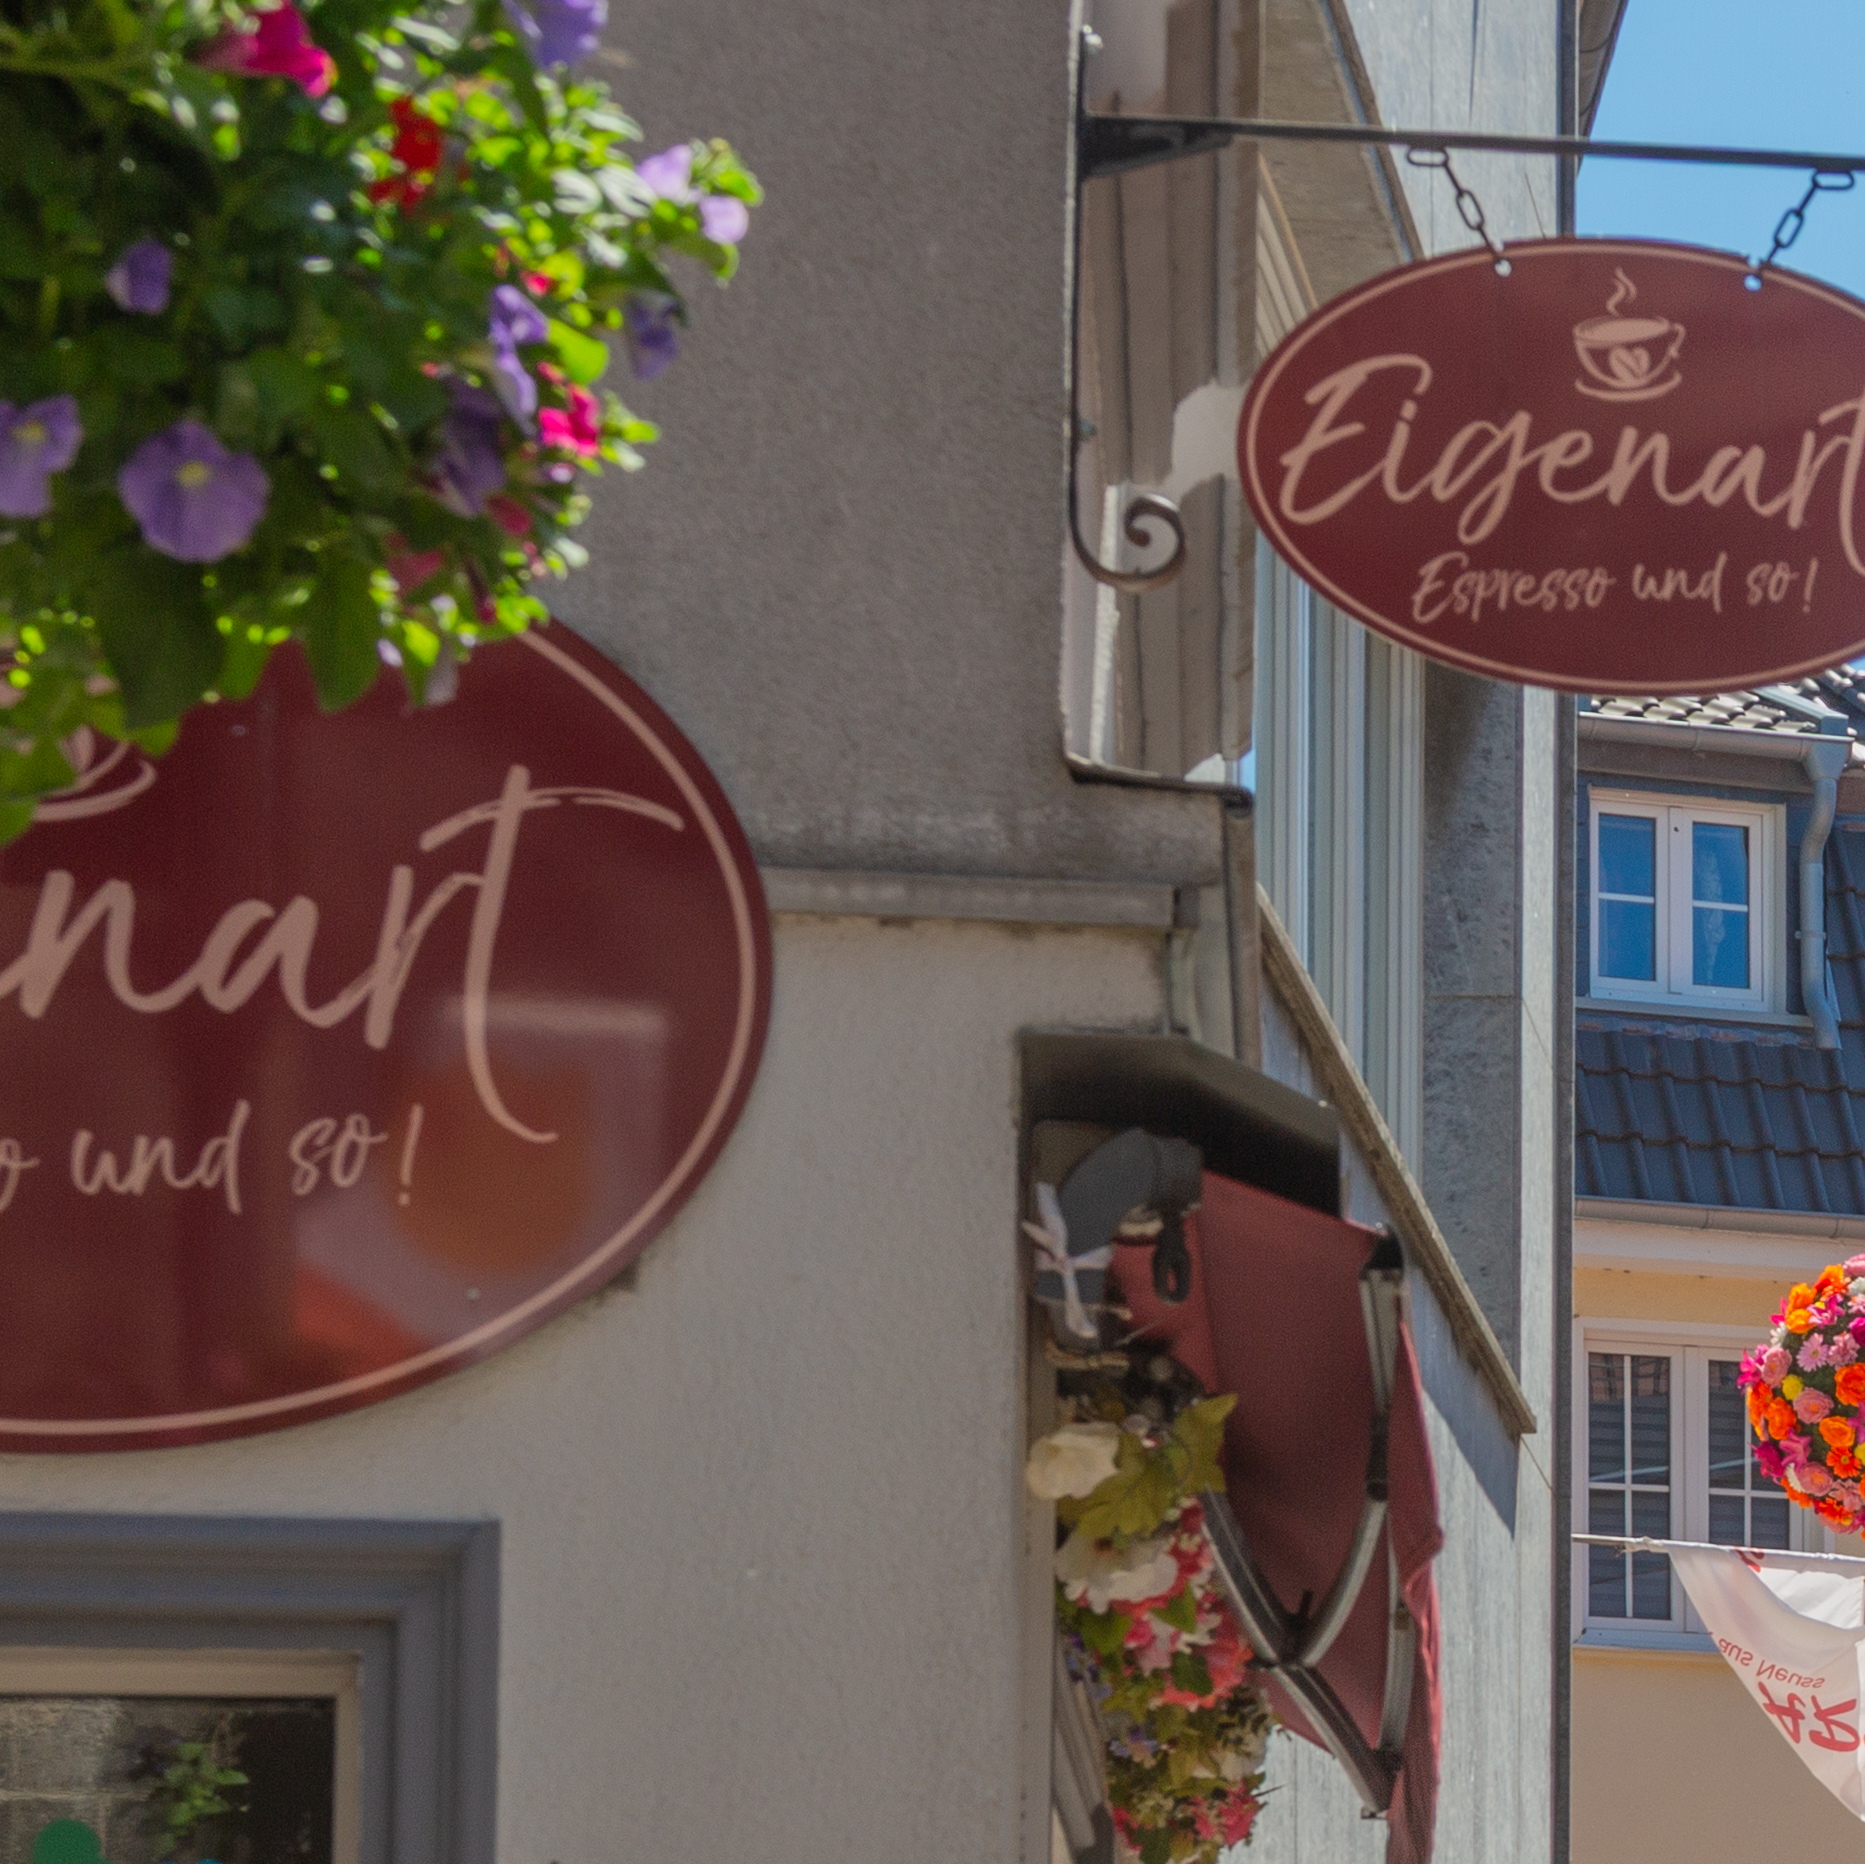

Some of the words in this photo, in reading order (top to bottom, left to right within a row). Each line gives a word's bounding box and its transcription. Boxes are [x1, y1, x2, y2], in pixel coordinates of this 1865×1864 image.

[1412, 551, 1615, 623] Espresso
[1632, 551, 1728, 613] und
[0, 765, 684, 1142] nart
[71, 1099, 250, 1215] und
